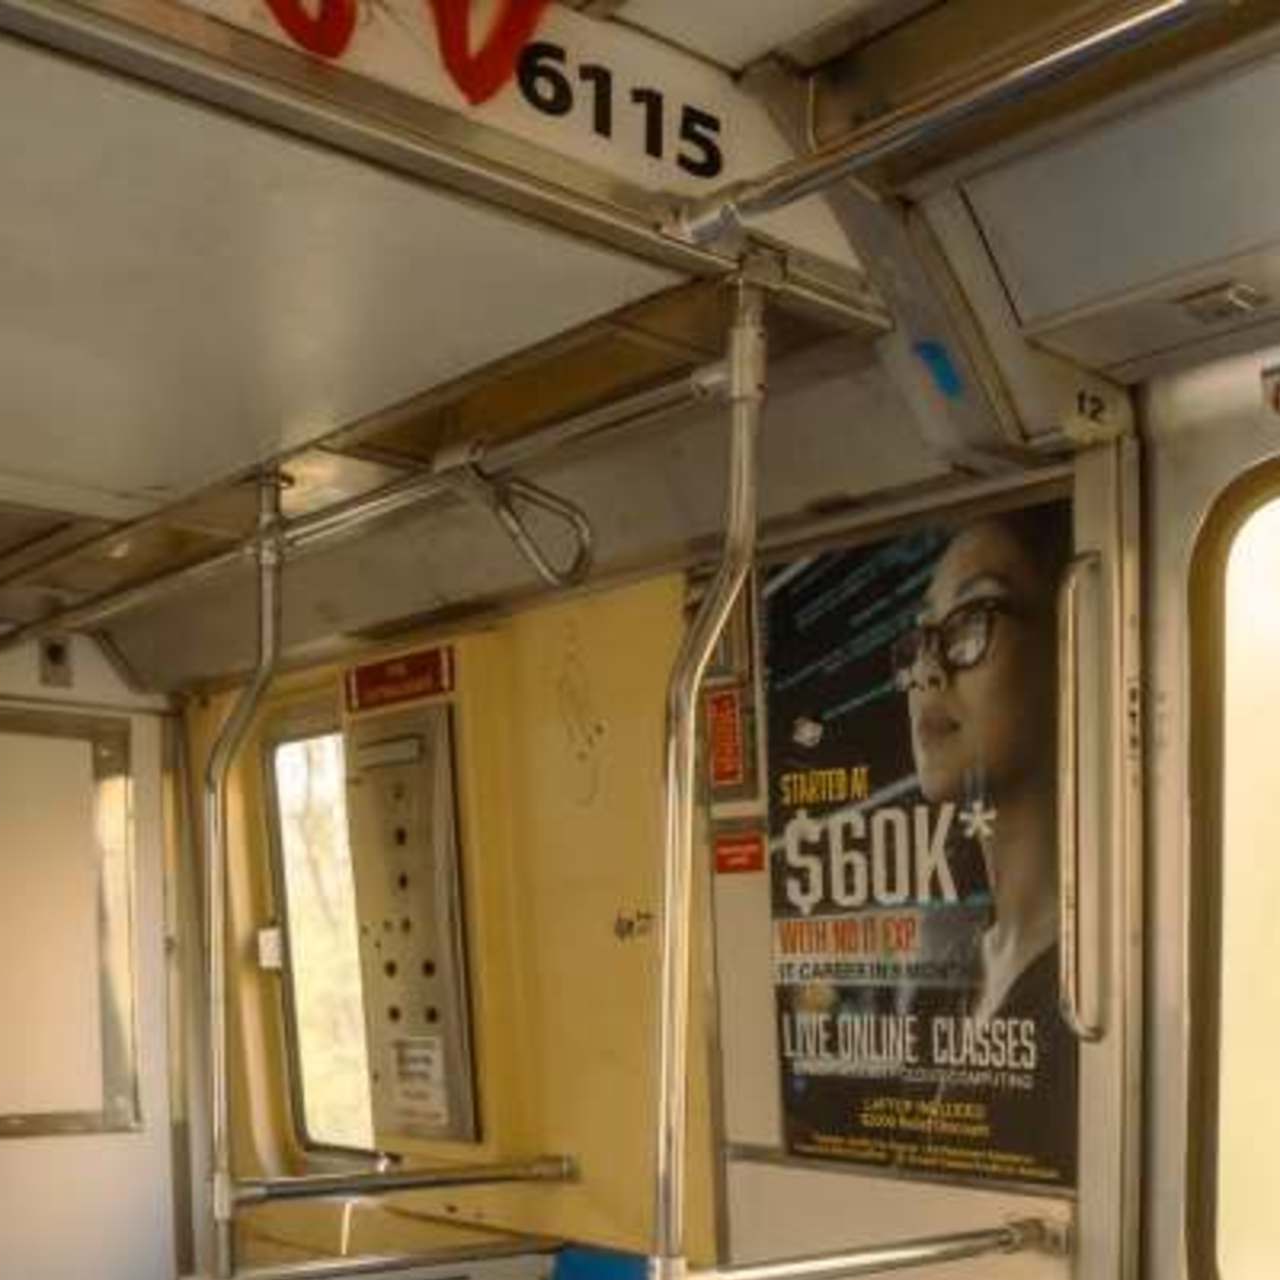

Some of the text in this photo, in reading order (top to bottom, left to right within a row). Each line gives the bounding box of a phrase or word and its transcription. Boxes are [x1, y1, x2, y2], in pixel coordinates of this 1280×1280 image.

[516, 42, 723, 178] 6115
[1076, 390, 1105, 421] 12
[783, 1011, 1038, 1070] LIVE ONLINE CLASSES
